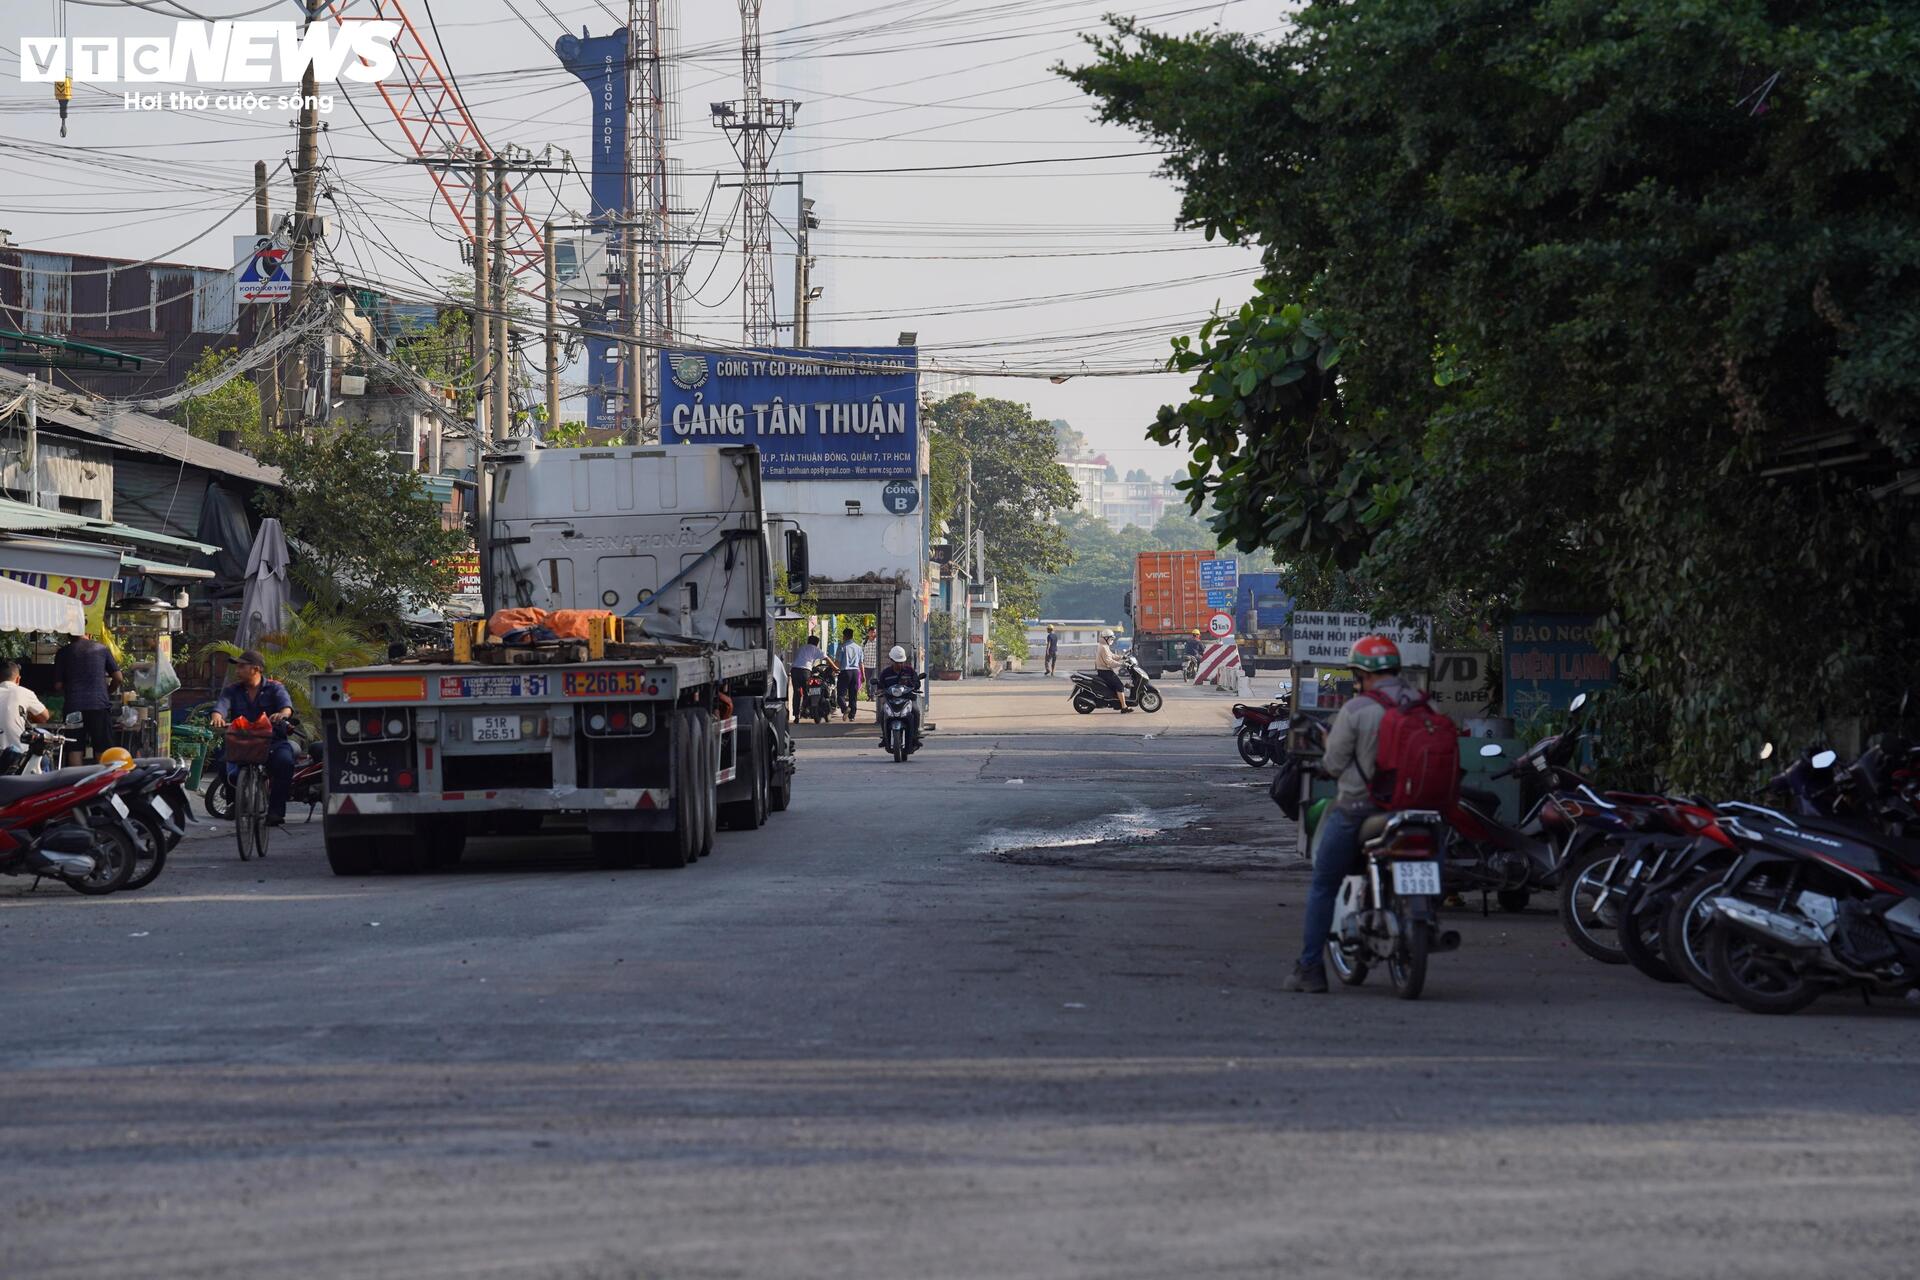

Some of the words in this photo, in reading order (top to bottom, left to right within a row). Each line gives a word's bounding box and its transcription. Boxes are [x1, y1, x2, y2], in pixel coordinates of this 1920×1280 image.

[604, 55, 613, 111] SAIGON
[604, 117, 613, 154] PORT
[716, 357, 749, 377] CÔNG
[751, 360, 766, 376] TY
[671, 375, 692, 390] SAIGON
[672, 392, 745, 436] CẢNG
[752, 396, 806, 435] TÂN
[814, 394, 905, 441] THUẬN
[770, 453, 778, 462] P.
[780, 452, 796, 462] TÂN
[797, 452, 823, 464] THUẬN
[824, 452, 849, 463] ĐÔNG,
[850, 452, 874, 463] QUẬN
[874, 453, 881, 462] 7,
[882, 452, 911, 462] TP.HCM
[770, 466, 786, 475] Email:
[855, 466, 868, 475] Web:
[869, 465, 912, 476] www.csg.com.vn
[885, 483, 916, 494] CỔNG
[895, 498, 908, 510] B
[551, 532, 703, 552] INTERNATIONAL
[1145, 571, 1171, 579] VIMC
[1211, 619, 1218, 631] 5
[1295, 614, 1324, 625] BÁNH
[1343, 615, 1367, 628] HEO
[1294, 629, 1324, 641] BÁNH
[1308, 644, 1331, 656] BÁN
[485, 717, 507, 729] 51R
[478, 729, 515, 740] 266.51
